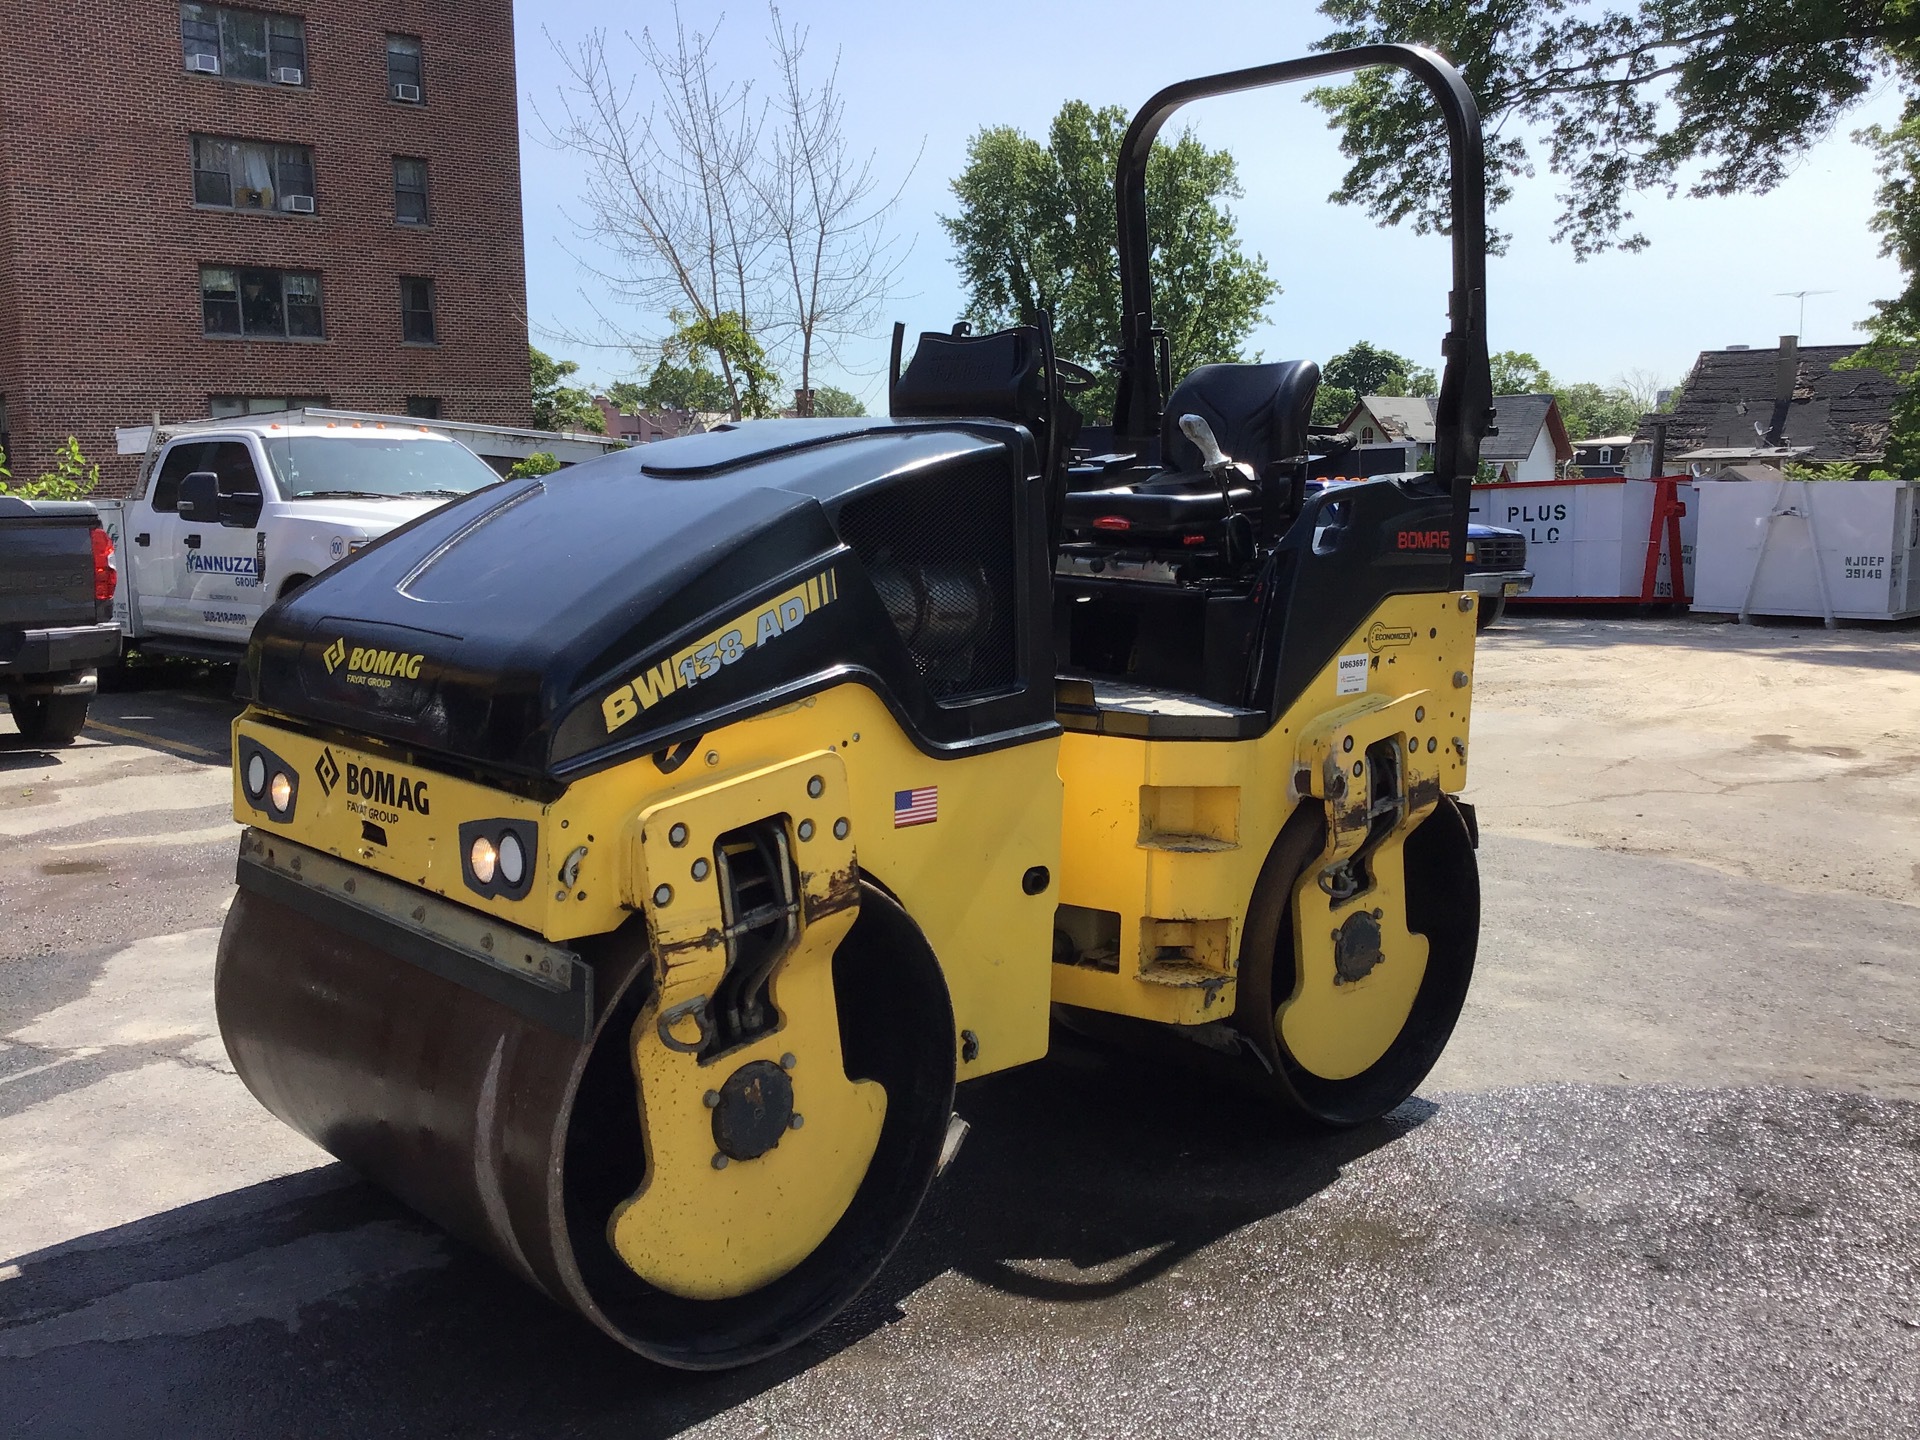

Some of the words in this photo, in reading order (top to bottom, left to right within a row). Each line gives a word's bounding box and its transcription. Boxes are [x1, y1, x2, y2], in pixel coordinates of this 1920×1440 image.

[1508, 504, 1566, 522] PLUS
[1398, 531, 1450, 549] BOMAG
[1516, 527, 1560, 544] LC
[331, 542, 342, 555] 100
[186, 551, 258, 573] YANNUZZI
[1845, 556, 1885, 566] NJDEP
[756, 596, 806, 648] AD
[1375, 632, 1411, 641] ECONOMIZER
[348, 647, 425, 680] BOMAG
[1340, 658, 1367, 669] U663697
[346, 674, 367, 685] FAYAT
[367, 677, 392, 689] GROUP
[346, 762, 430, 816] BOMAG
[346, 800, 368, 818] FAYAT
[368, 807, 399, 825] GROUP
